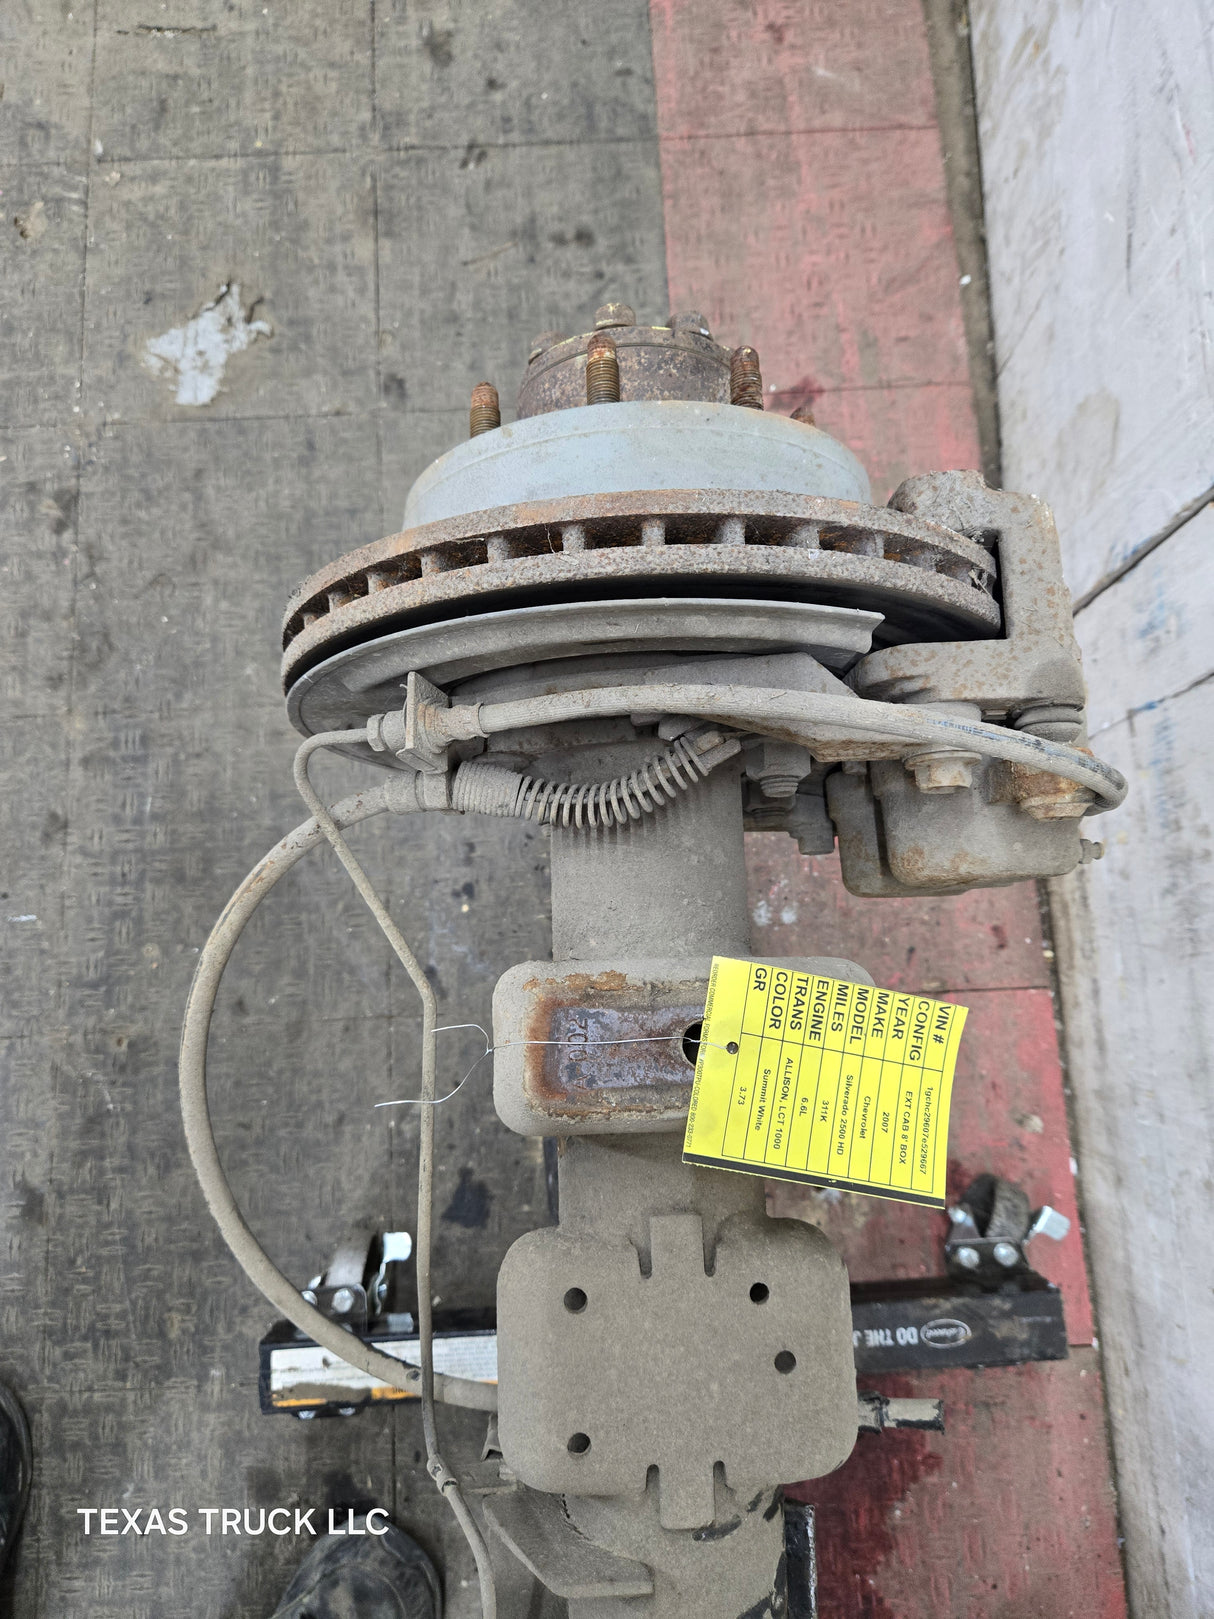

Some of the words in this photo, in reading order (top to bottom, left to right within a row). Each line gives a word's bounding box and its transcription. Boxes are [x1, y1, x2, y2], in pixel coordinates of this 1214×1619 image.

[753, 967, 767, 992] GR
[706, 988, 716, 1022] COMMERCIAL
[769, 972, 788, 1030] COLOR
[790, 976, 809, 1031] TRANS
[809, 980, 829, 1042] ENGINE
[831, 984, 849, 1032] MILES
[850, 988, 869, 1045] MODEL
[871, 992, 889, 1039] MAKE
[892, 997, 910, 1040] YEAR
[934, 1005, 951, 1031] VIN
[702, 1023, 710, 1042] FORMS
[909, 1000, 930, 1061] CONFIG
[933, 1034, 944, 1044] #
[760, 1068, 771, 1103] Summit
[780, 1057, 793, 1104] ALLISON,
[738, 1086, 747, 1105] 3.73
[799, 1097, 809, 1116] 6.6L
[842, 1075, 854, 1116] Silverado
[905, 1091, 913, 1110] EXT
[755, 1105, 765, 1131] White
[777, 1106, 786, 1126] LCT
[820, 1100, 829, 1122] 311K
[859, 1096, 871, 1139] Chevrolet
[882, 1112, 890, 1134] 2007
[903, 1112, 911, 1131] CAB
[773, 1128, 783, 1150] 1000
[839, 1118, 848, 1140] 2500
[836, 1142, 844, 1156] HD
[899, 1144, 908, 1164] BOX
[864, 1327, 894, 1348] THE
[896, 1326, 919, 1347] DO
